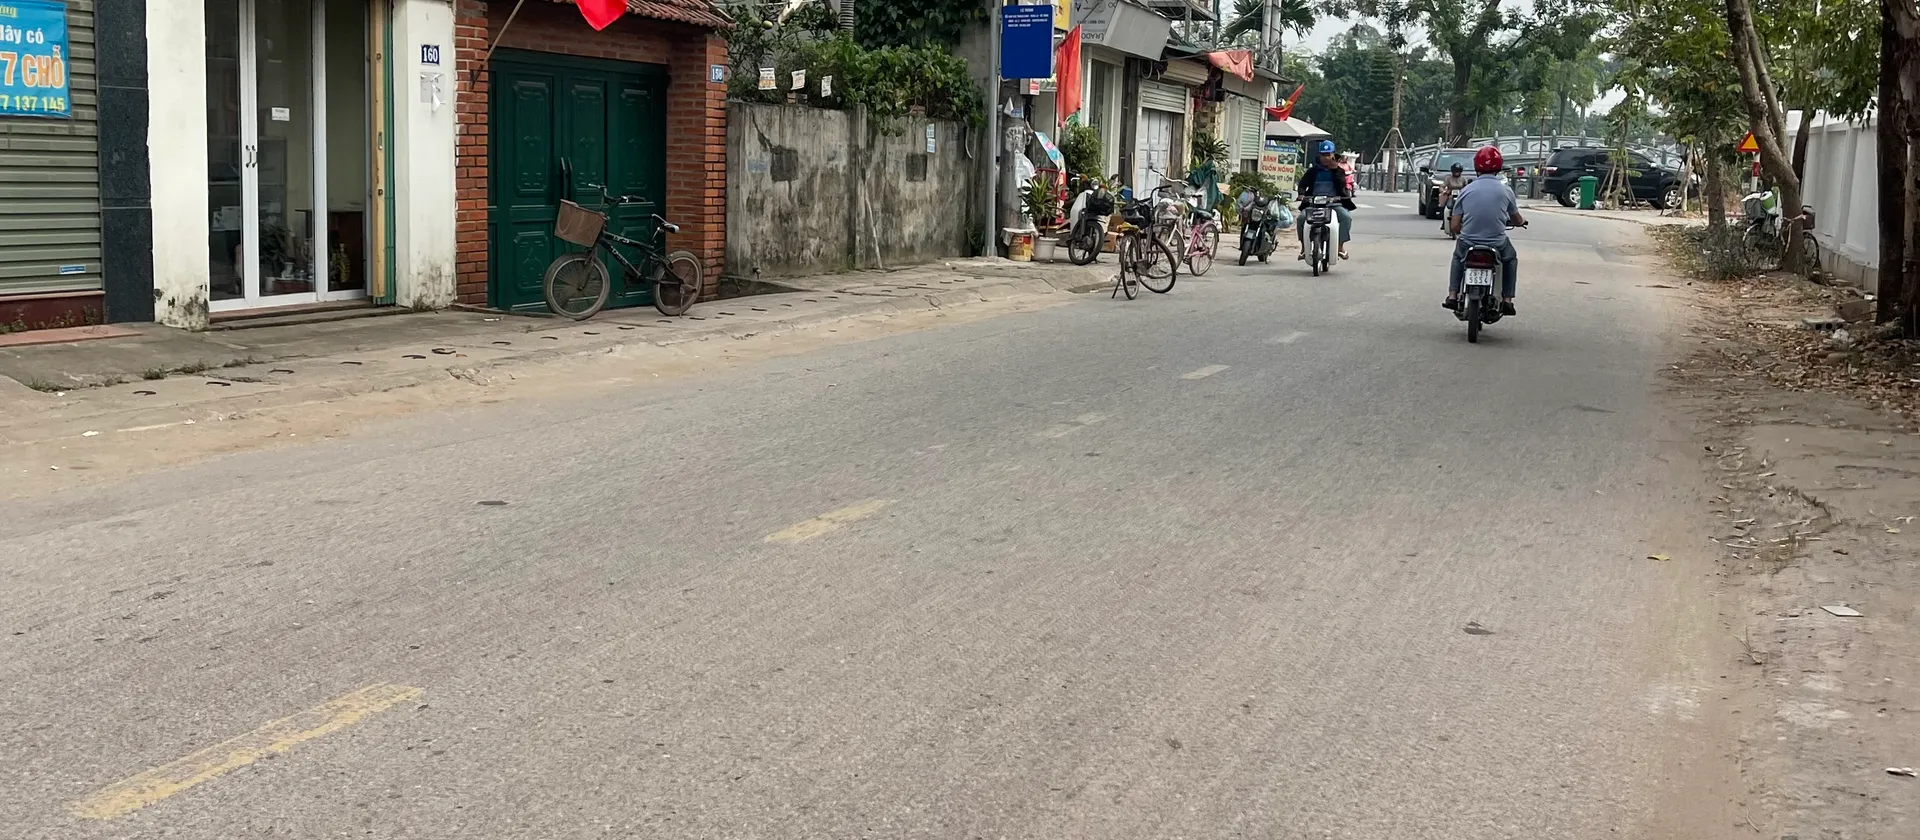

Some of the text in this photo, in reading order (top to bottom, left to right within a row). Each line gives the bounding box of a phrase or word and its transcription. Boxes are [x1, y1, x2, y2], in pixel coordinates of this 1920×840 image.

[26, 28, 43, 44] có
[423, 47, 438, 62] 160
[0, 45, 64, 88] 7 CHỖ
[712, 68, 722, 79] 158
[14, 95, 37, 111] 137
[41, 96, 65, 112] 145
